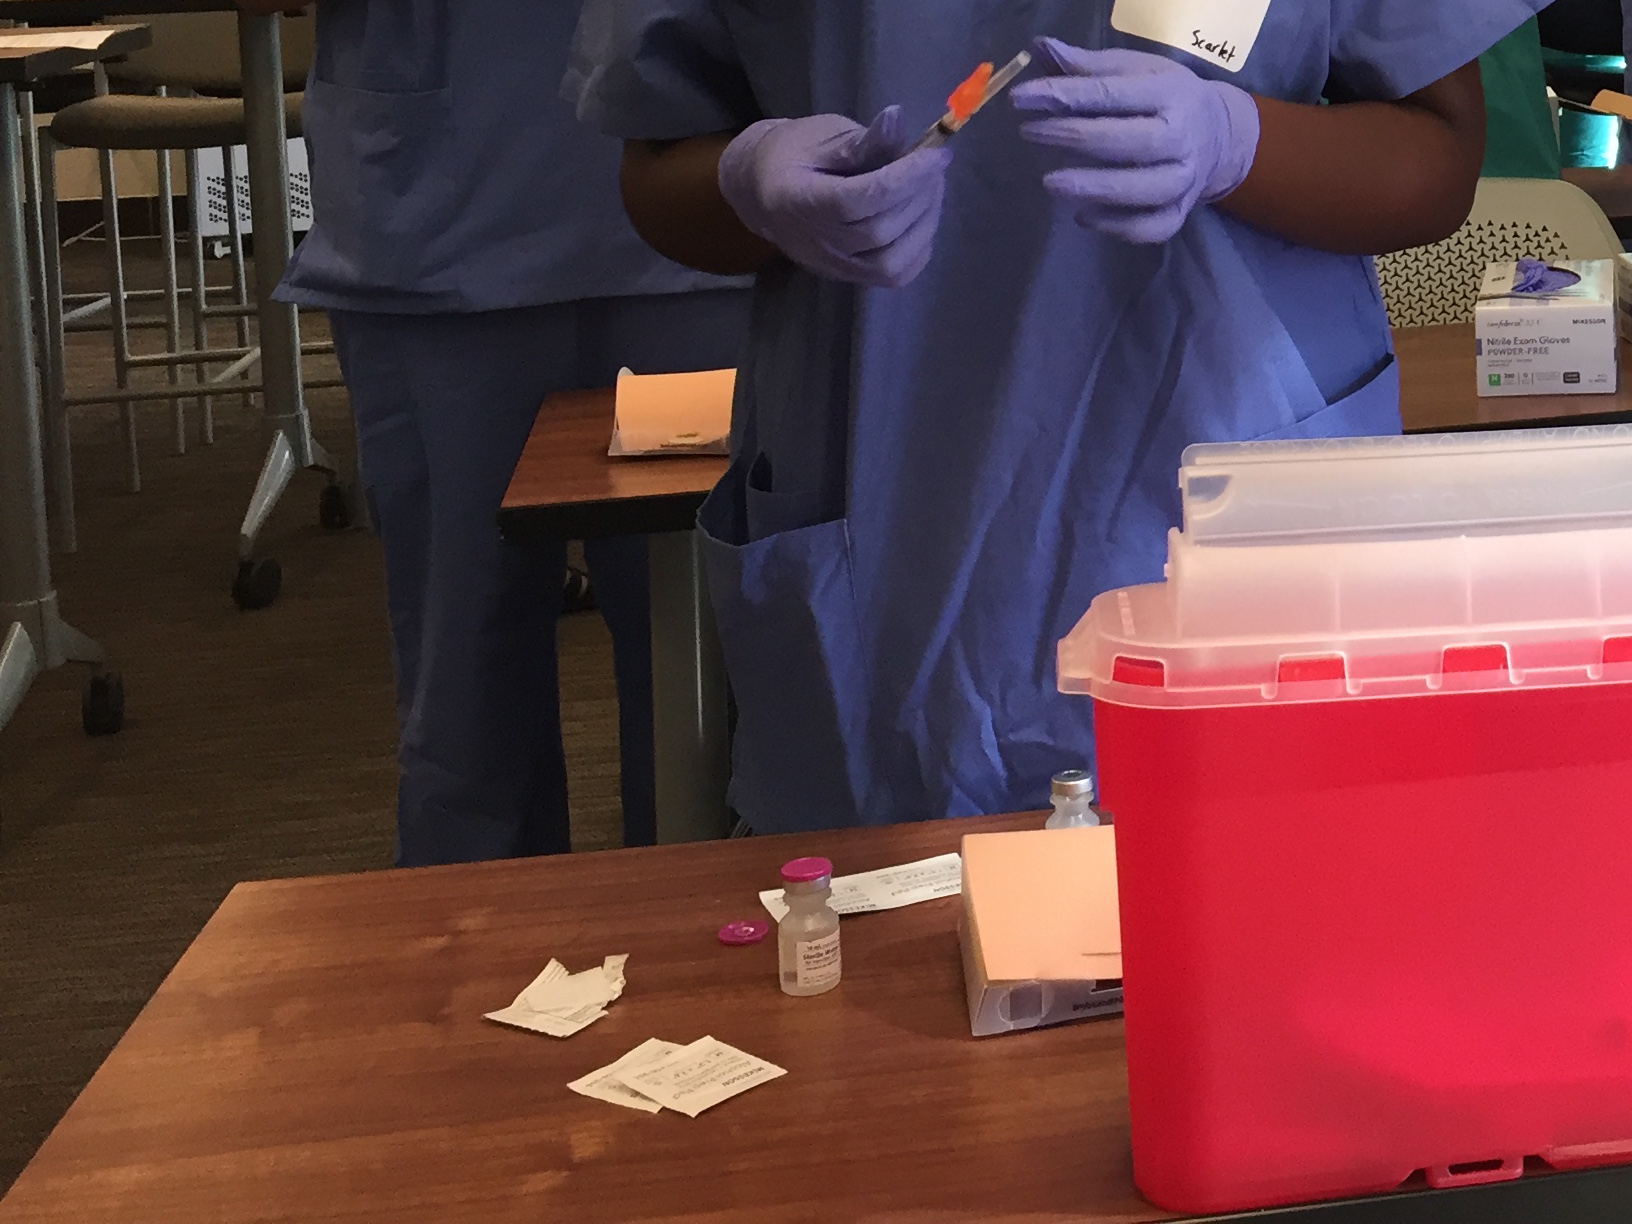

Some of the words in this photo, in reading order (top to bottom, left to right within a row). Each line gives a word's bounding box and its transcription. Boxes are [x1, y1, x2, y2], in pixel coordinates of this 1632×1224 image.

[1487, 336, 1512, 346] Nitrile
[1513, 336, 1538, 345] Exam
[1539, 335, 1571, 345] Gloves
[1487, 346, 1550, 356] POWDER-FREE
